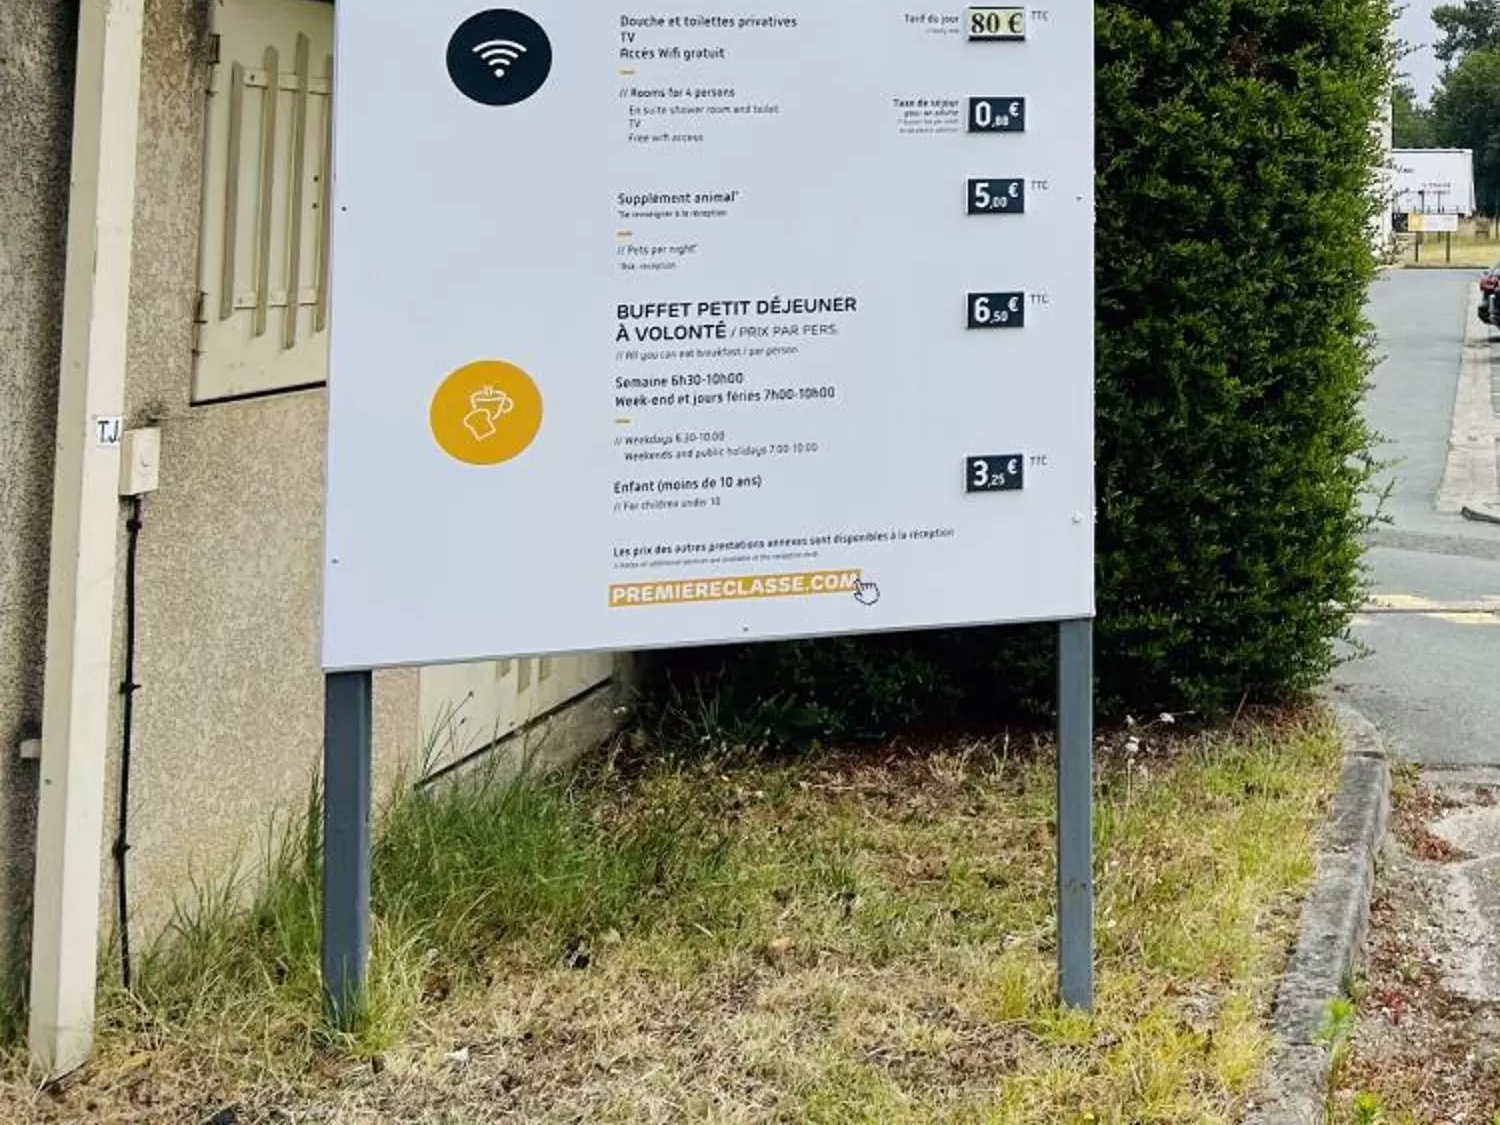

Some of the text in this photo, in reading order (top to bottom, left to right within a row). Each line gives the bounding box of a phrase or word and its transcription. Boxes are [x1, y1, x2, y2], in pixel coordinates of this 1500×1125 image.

[619, 14, 798, 29] Douche et toilettes privatives
[971, 12, 999, 33] 80
[620, 31, 636, 43] TV
[616, 295, 857, 320] BUFFET PETIT DÉJEUNER
[615, 323, 630, 342] À
[634, 321, 727, 342] VOLONTÉ
[615, 371, 744, 389] Semaine 6h30-10h00
[612, 474, 762, 494] Enfant (moins de 10 ans)
[610, 572, 860, 605] PREMIERECLASSE.COM
